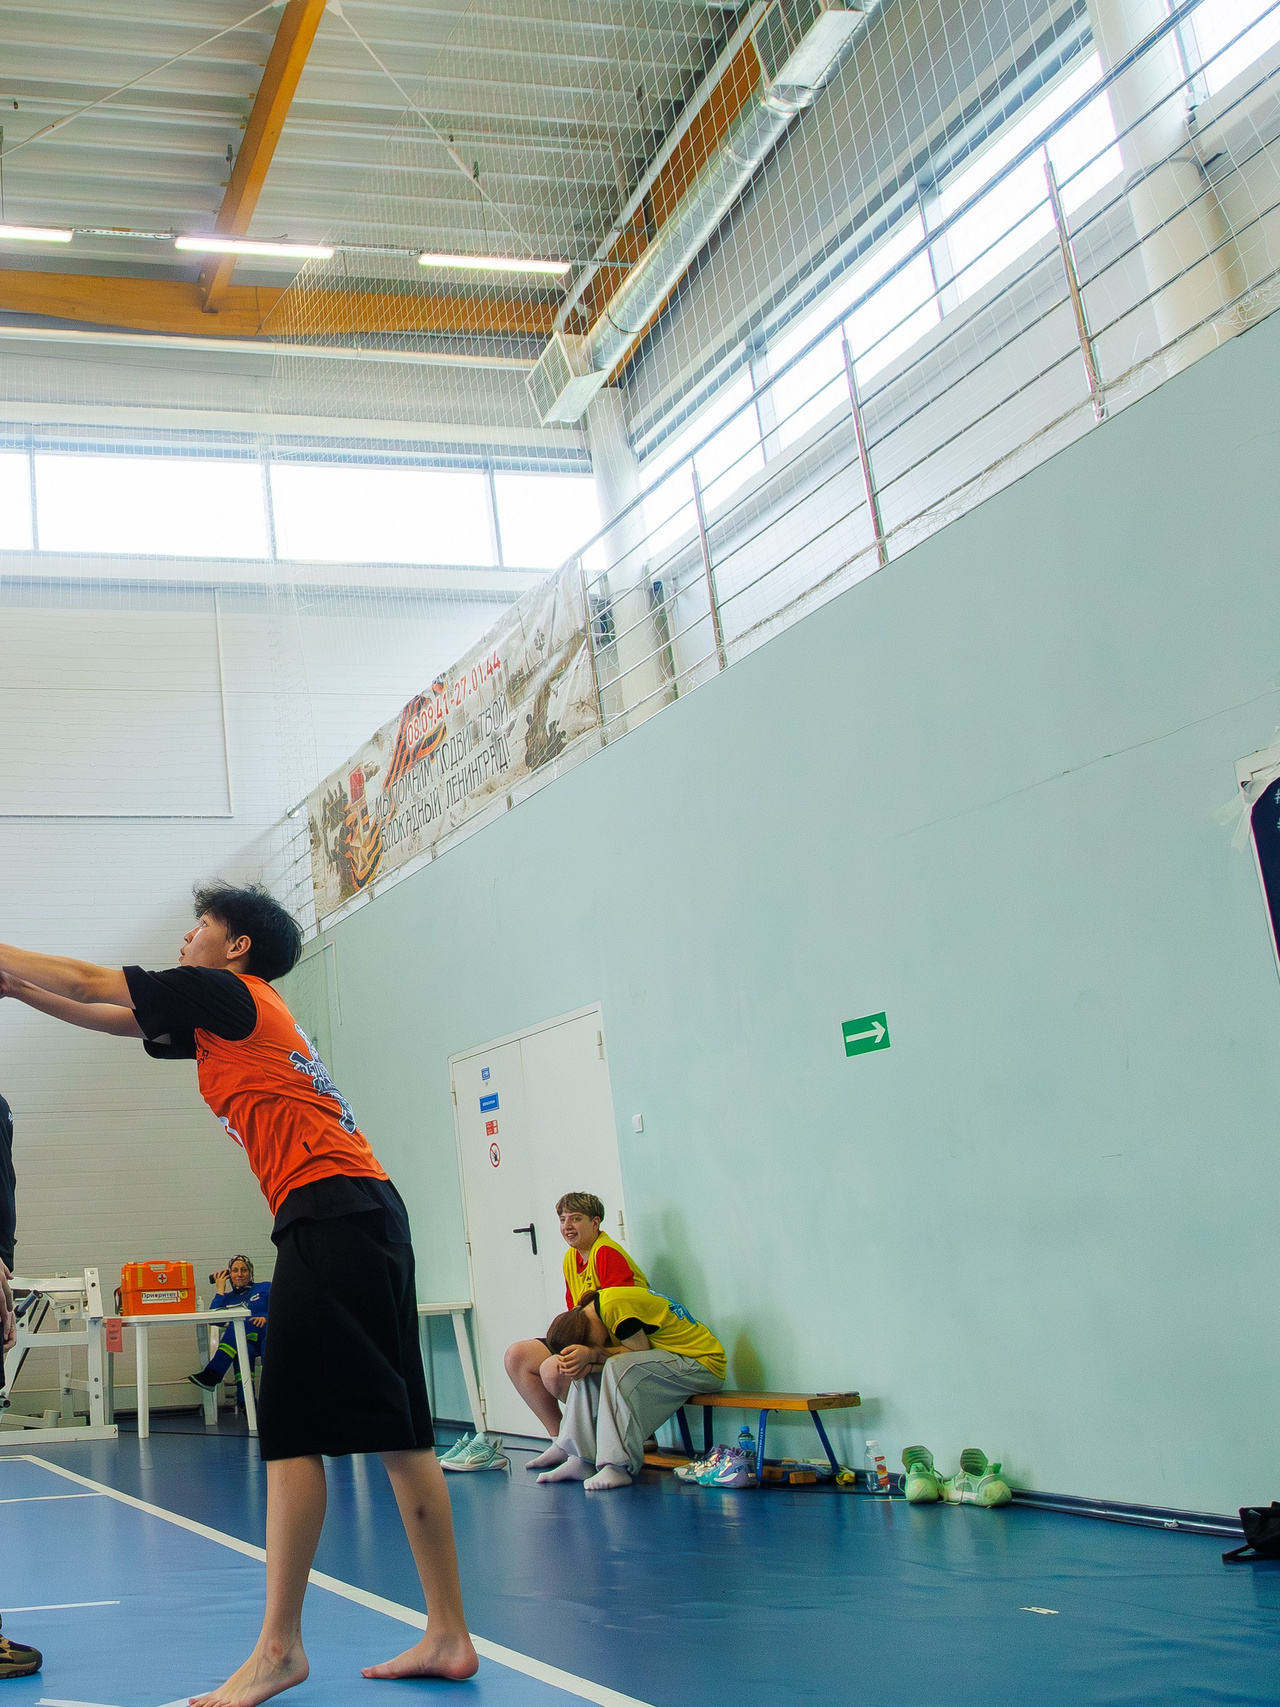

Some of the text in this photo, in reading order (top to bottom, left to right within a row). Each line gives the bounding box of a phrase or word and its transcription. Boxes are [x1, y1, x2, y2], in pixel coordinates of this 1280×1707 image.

[381, 733, 511, 853] БЛОКАДНЫЙ ЛЕНИНГРАД!
[391, 759, 433, 809] ПОМНИМ
[435, 721, 473, 777] ПОДВИГ
[478, 690, 509, 741] ТВОЙ
